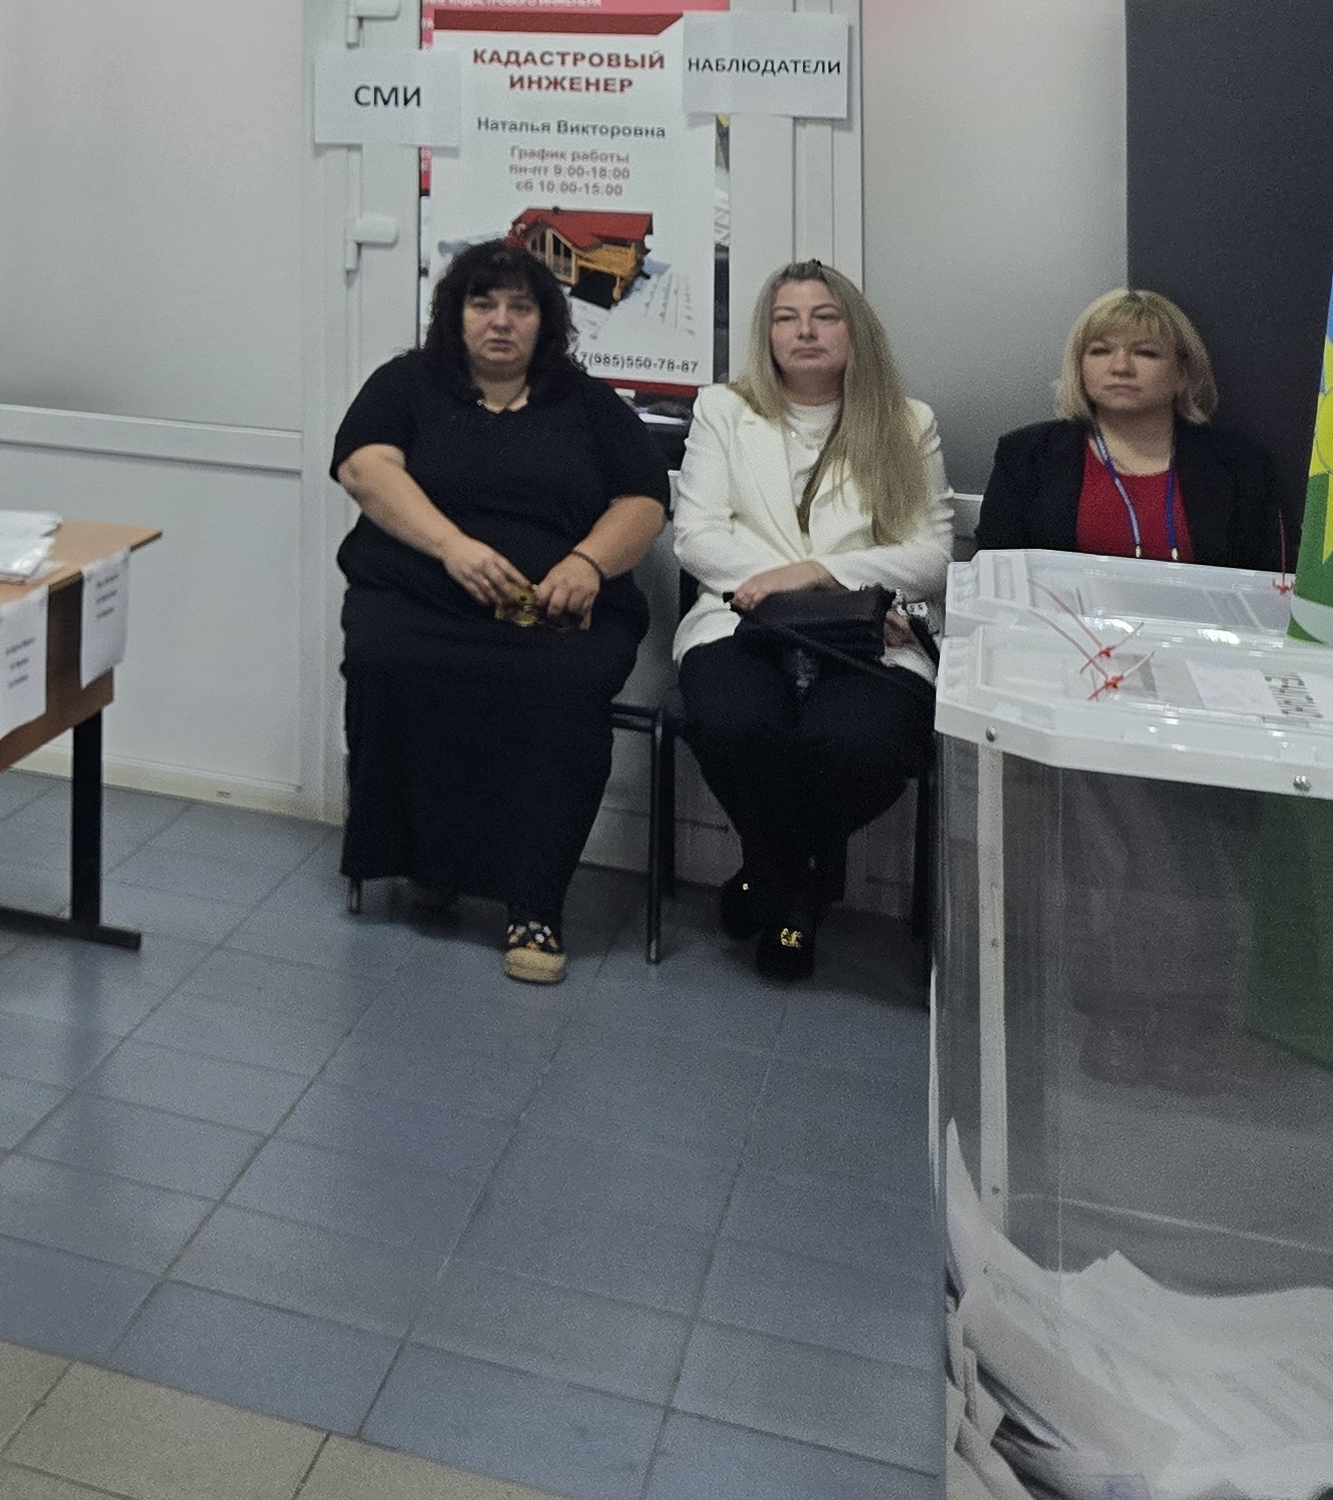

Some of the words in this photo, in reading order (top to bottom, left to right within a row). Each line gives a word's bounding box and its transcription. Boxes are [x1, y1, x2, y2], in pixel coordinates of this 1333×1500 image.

[473, 49, 665, 70] КАДАСТРОВЫЙ
[687, 55, 842, 77] НАБЛЮДАТЕЛИ
[509, 74, 633, 94] ИНЖЕНЕР
[354, 84, 423, 108] СМИ
[477, 116, 551, 134] Наталья
[557, 120, 666, 140] Викторовна
